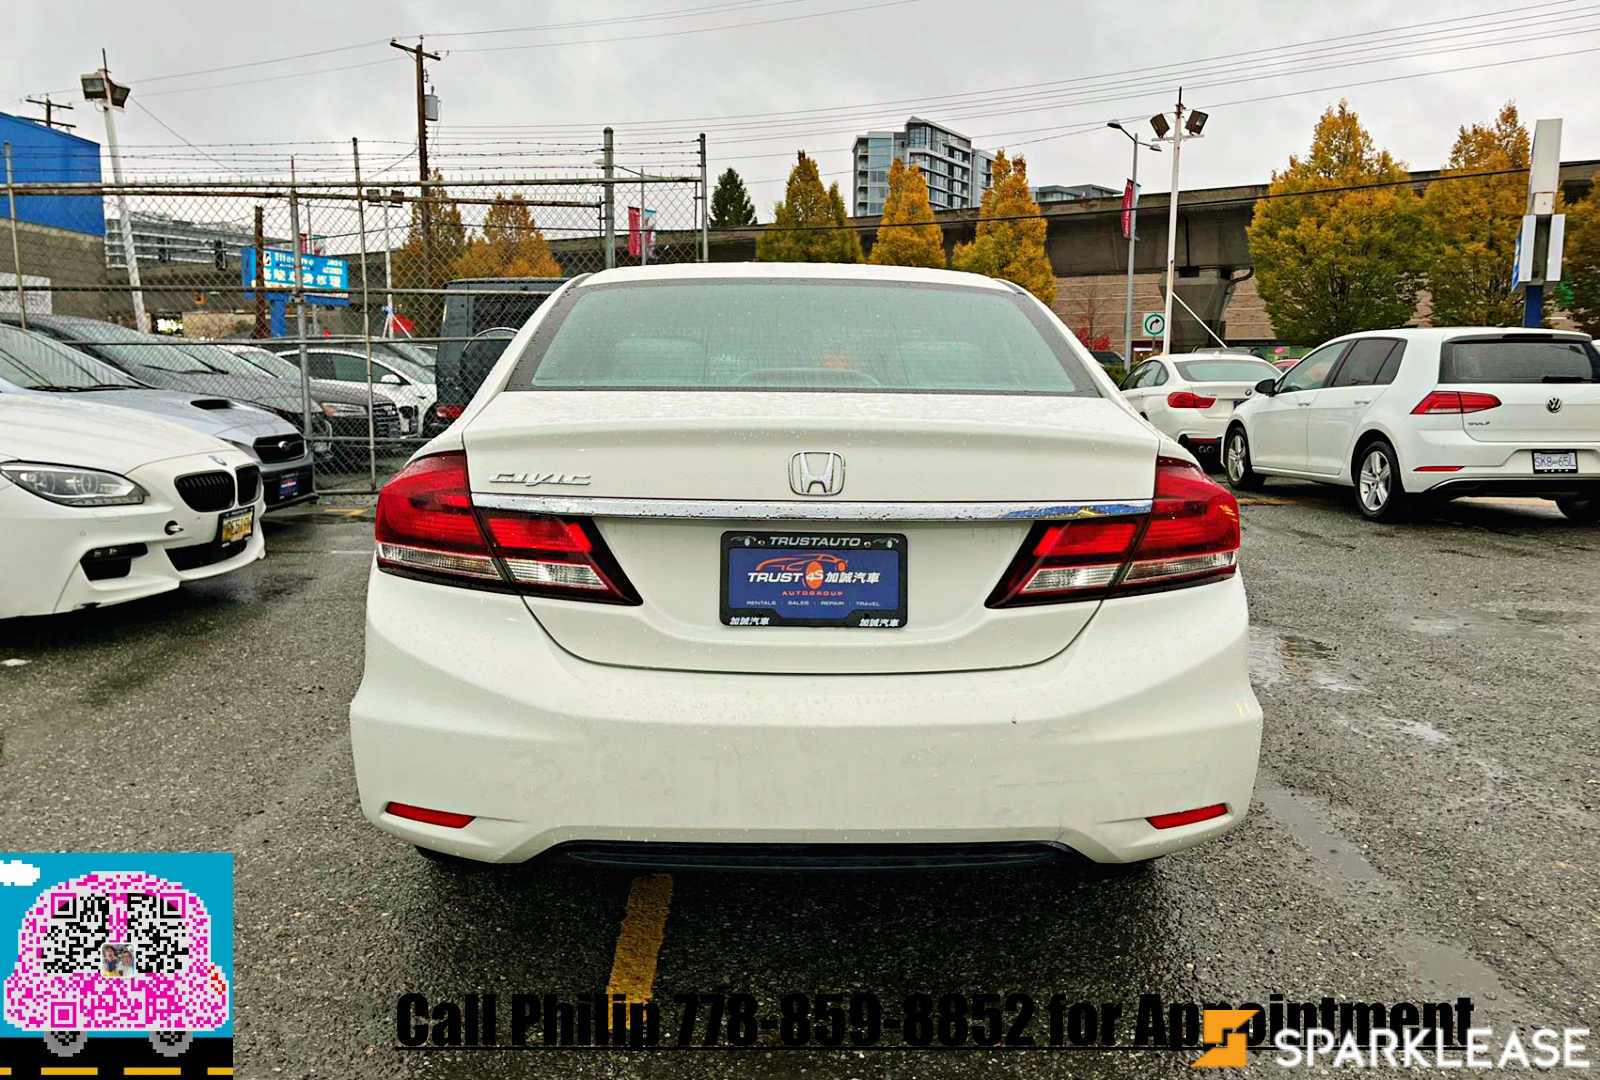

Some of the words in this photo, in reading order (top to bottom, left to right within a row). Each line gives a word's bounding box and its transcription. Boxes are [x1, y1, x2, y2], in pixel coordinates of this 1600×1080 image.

[488, 473, 591, 487] CIVIC
[769, 536, 861, 547] TRUSTAUTO
[747, 572, 803, 583] TRUST
